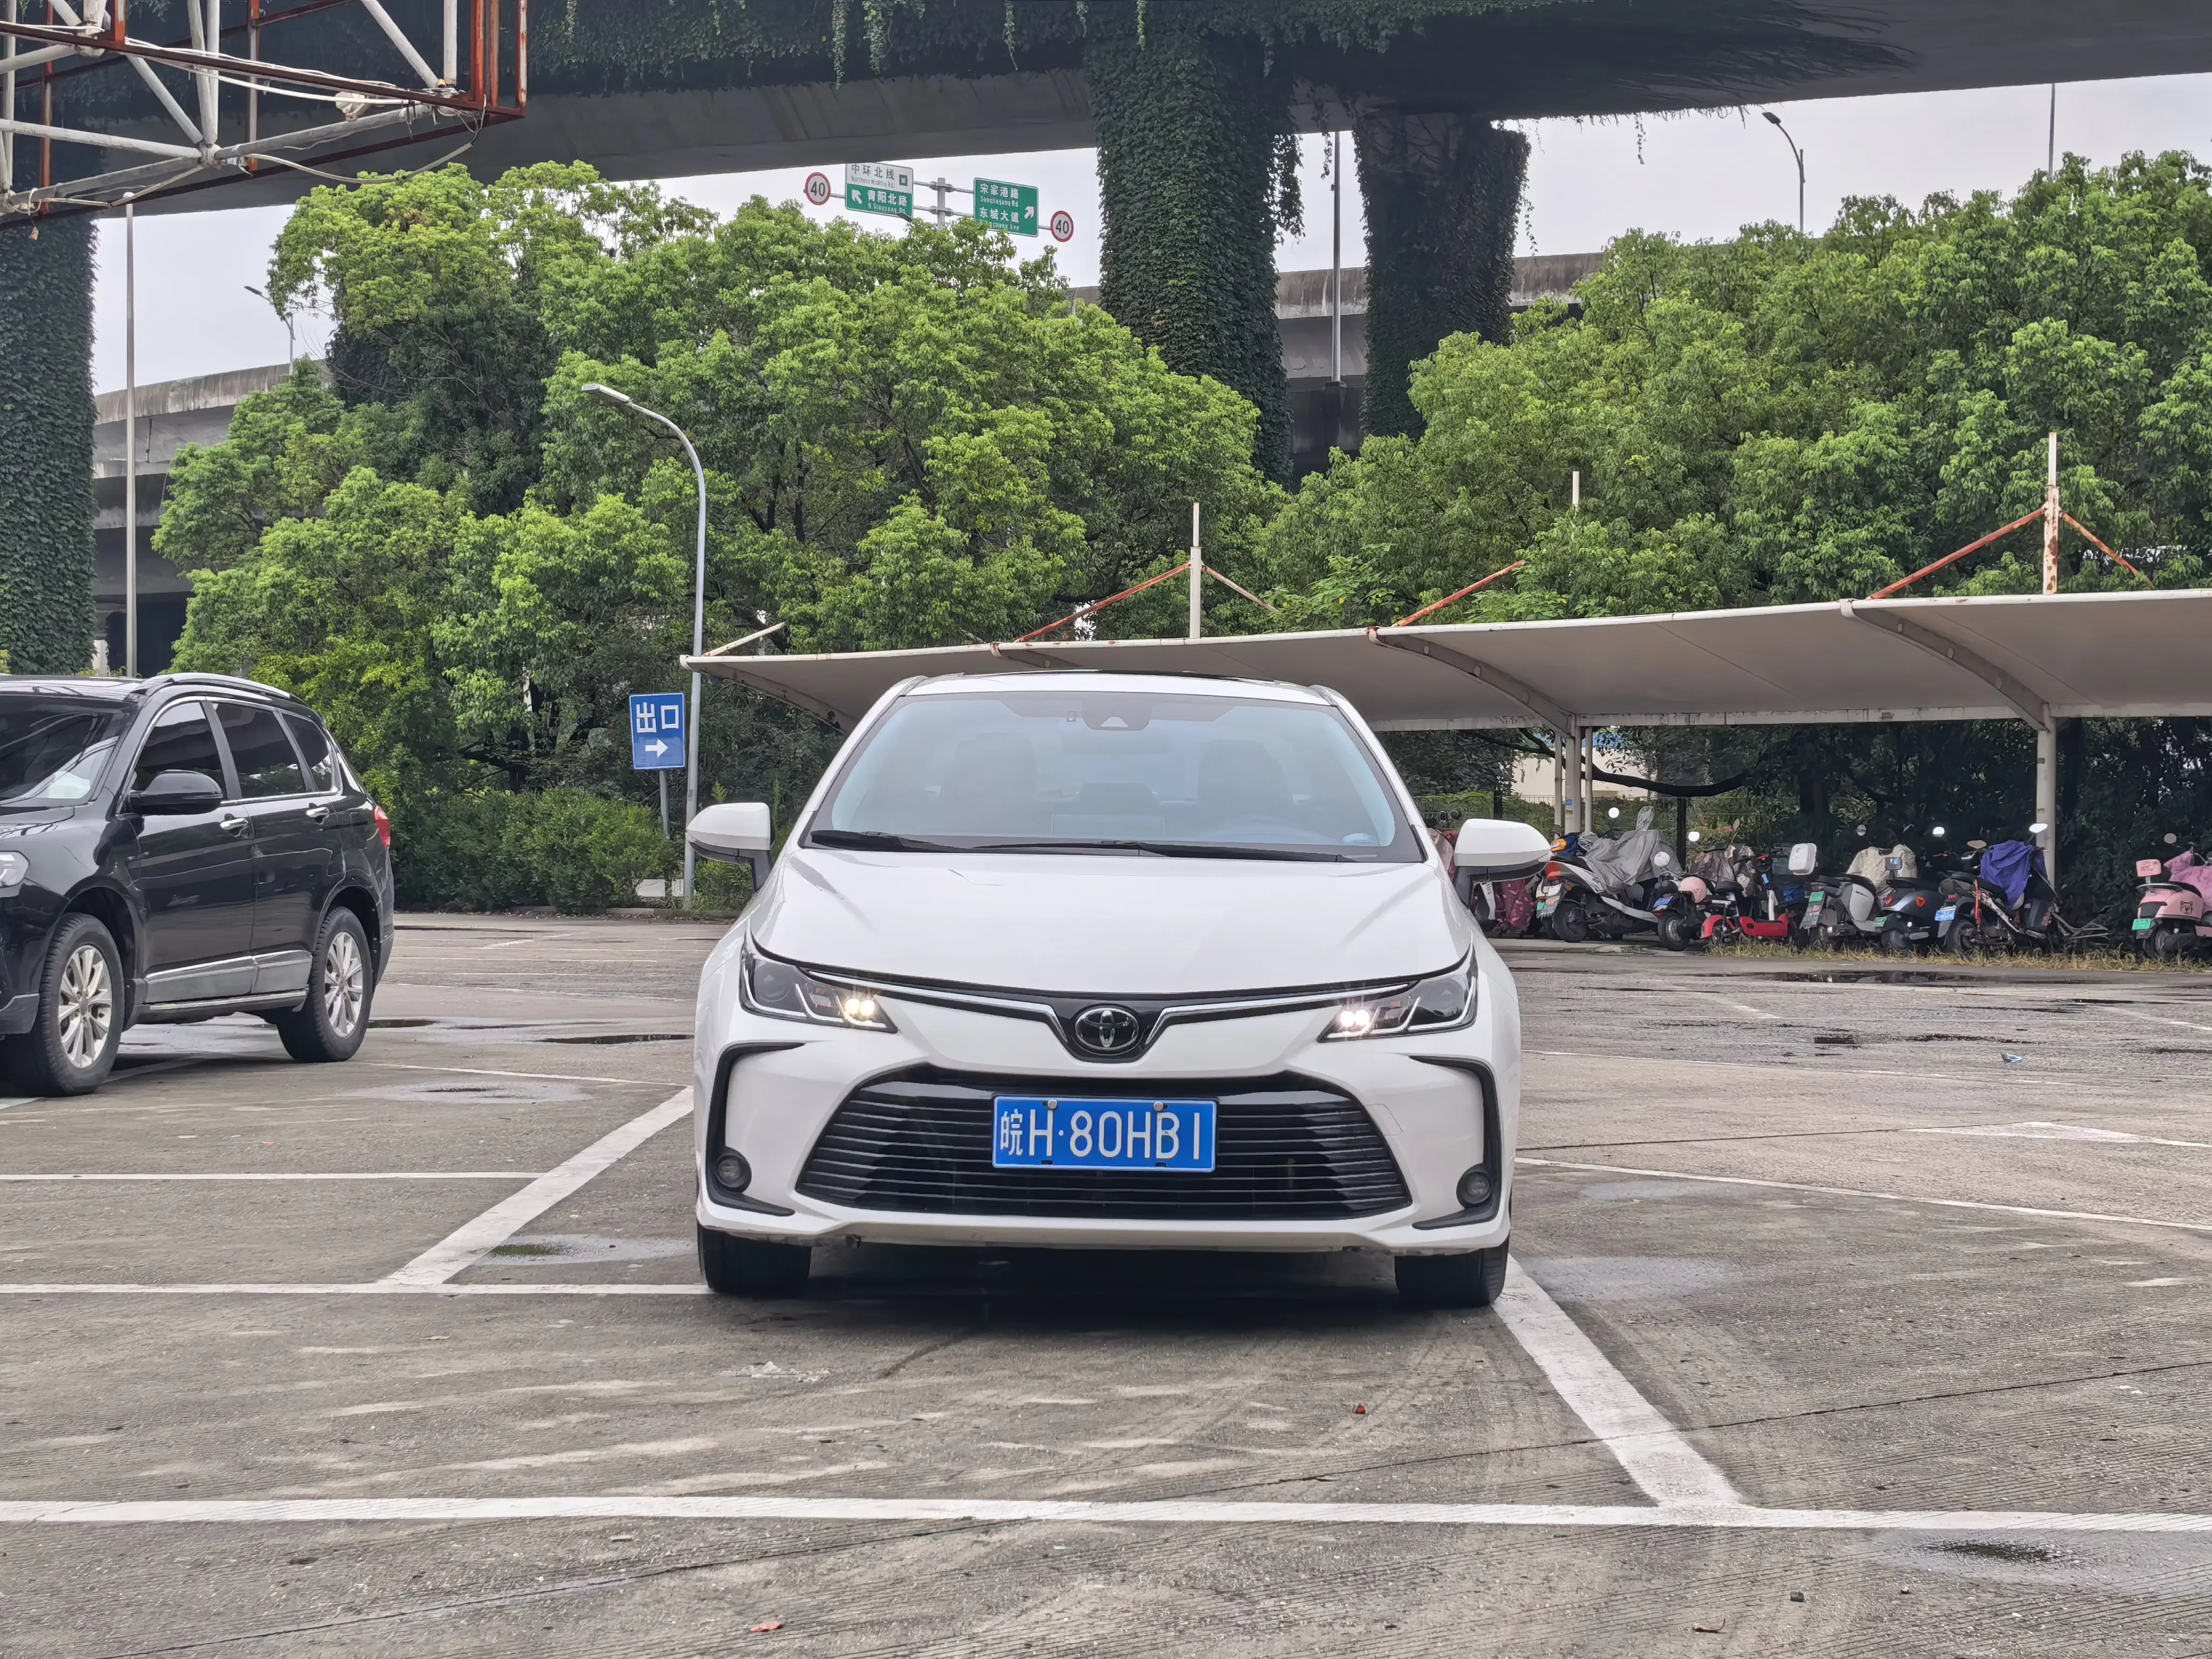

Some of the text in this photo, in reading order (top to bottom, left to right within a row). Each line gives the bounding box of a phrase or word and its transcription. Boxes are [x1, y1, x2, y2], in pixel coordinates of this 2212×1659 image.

[852, 164, 894, 180] 中环北线
[811, 181, 825, 197] 40
[980, 183, 1019, 199] 宋家港路
[868, 189, 907, 206] 青阳北路
[980, 207, 1019, 223] 东城大道
[1055, 219, 1069, 234] 40
[636, 702, 679, 733] 出口
